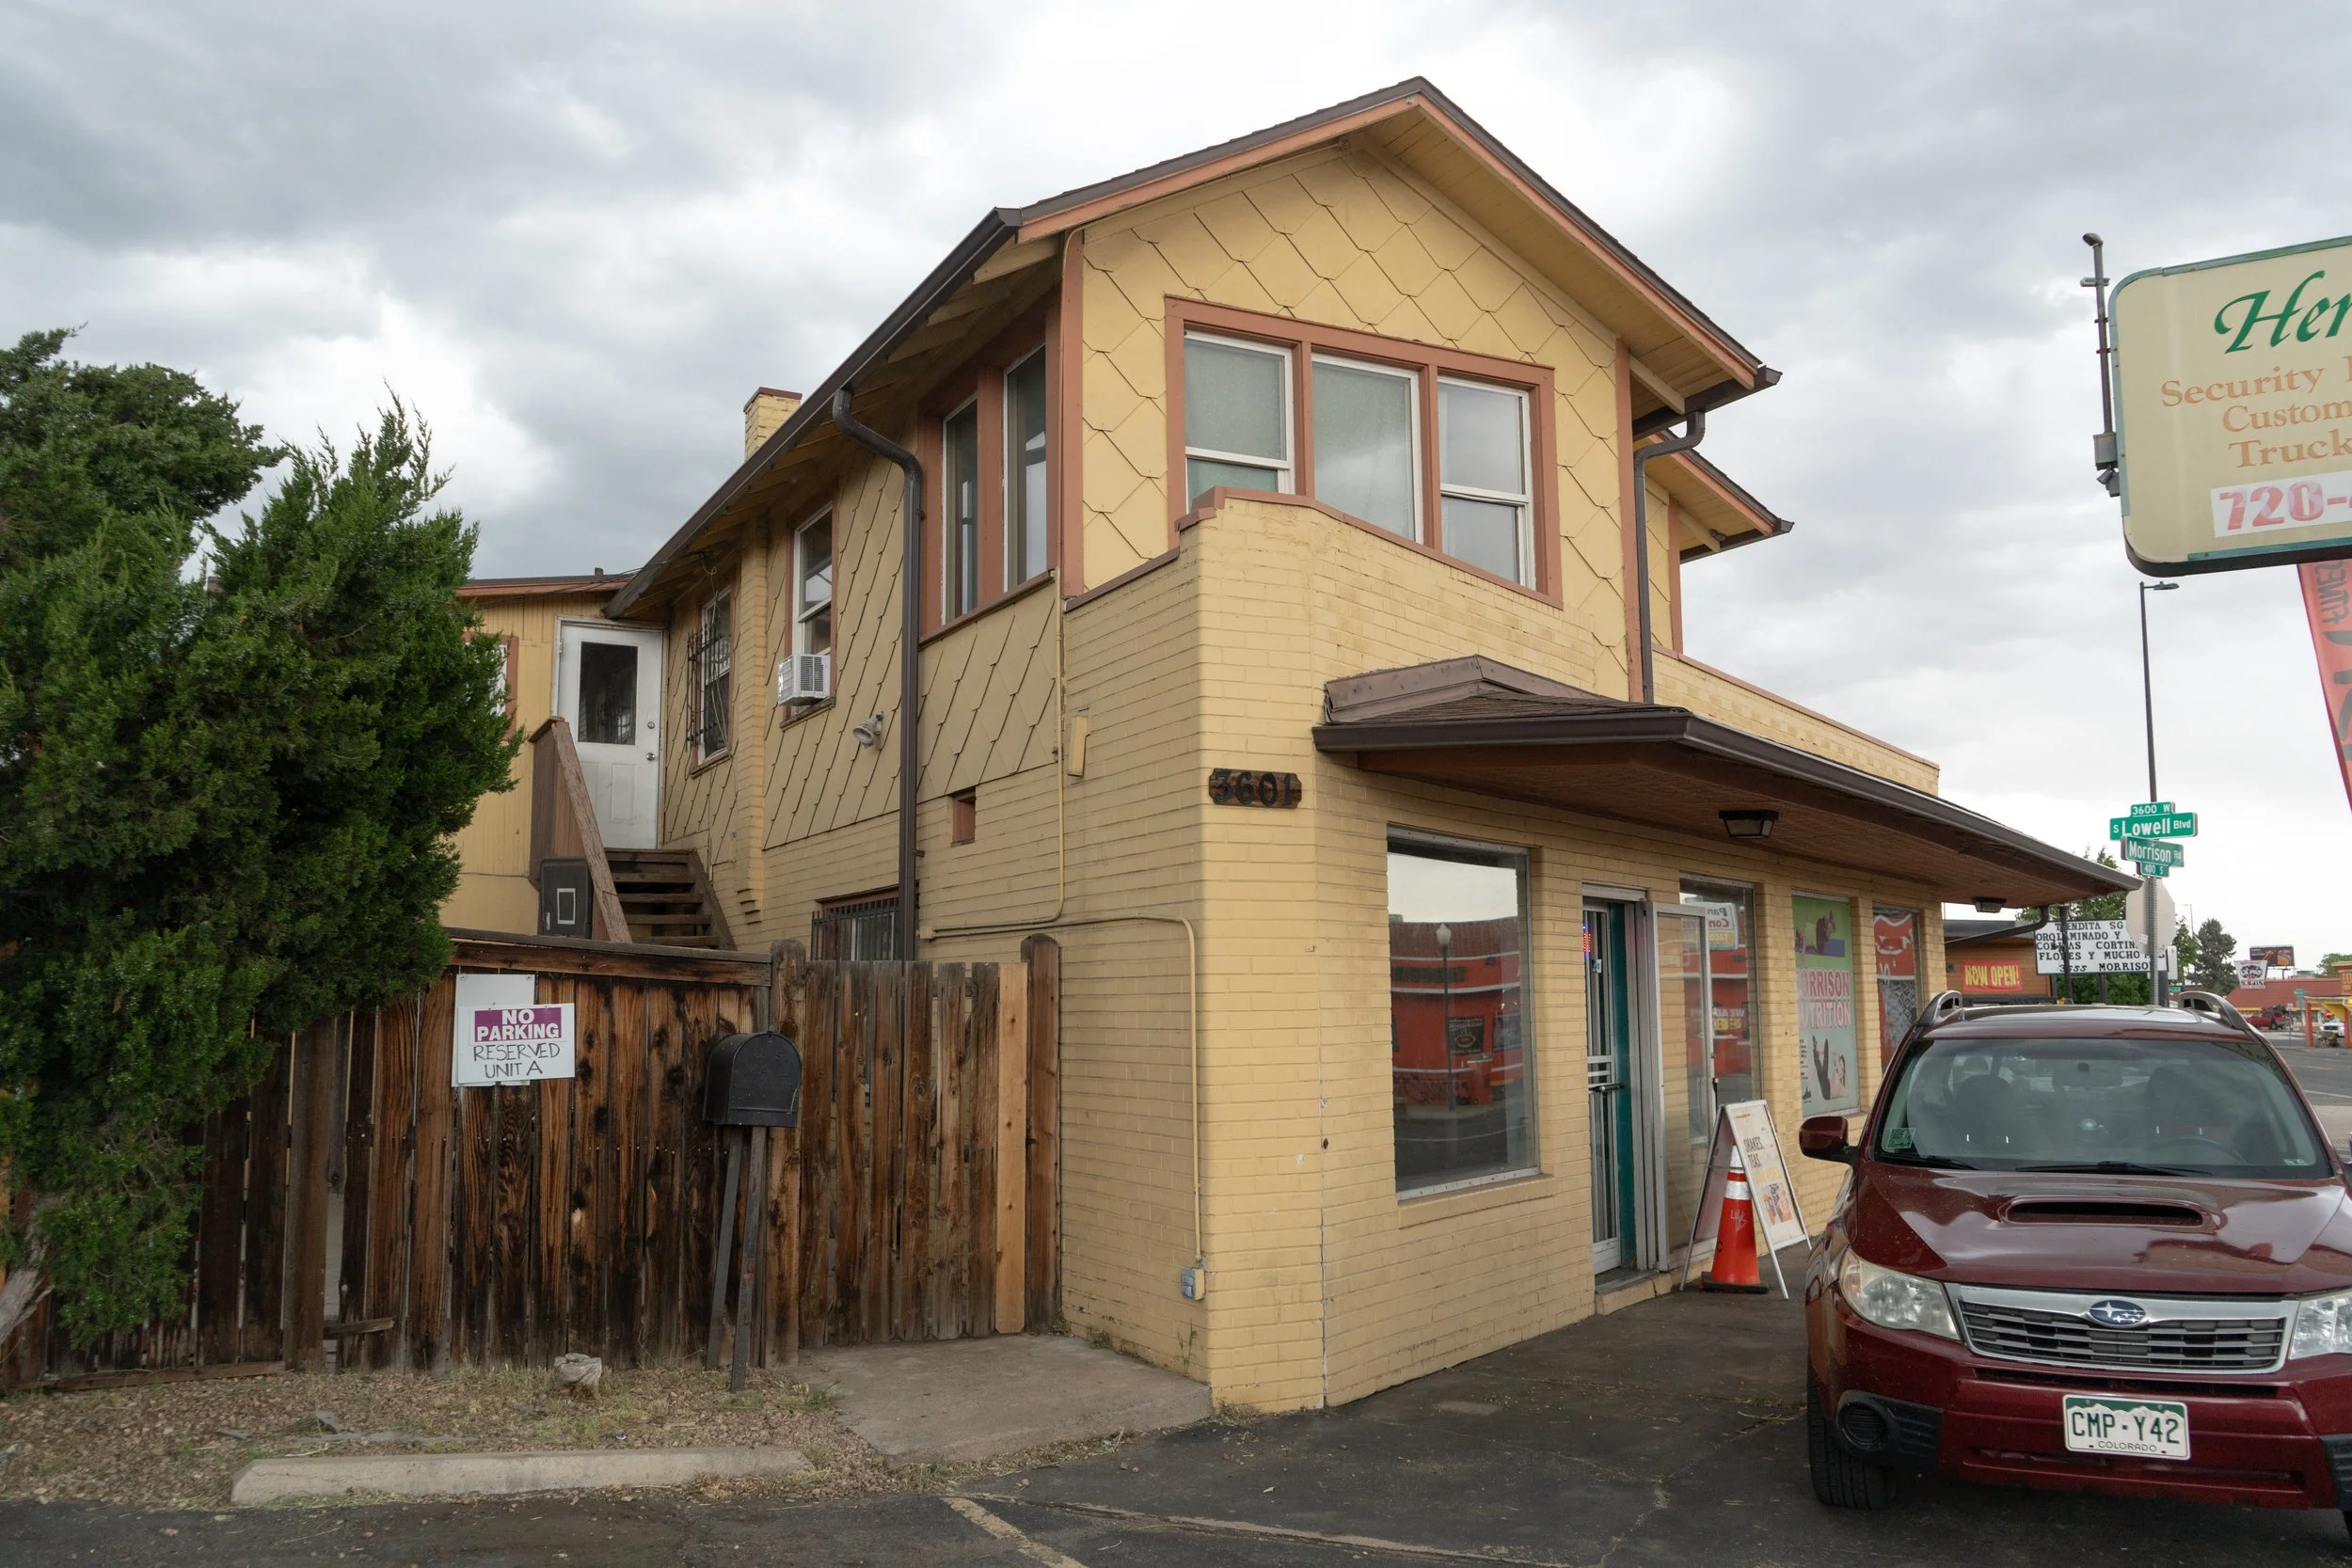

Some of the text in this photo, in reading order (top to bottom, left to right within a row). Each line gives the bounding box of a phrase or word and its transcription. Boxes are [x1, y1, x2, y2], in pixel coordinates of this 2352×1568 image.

[2214, 270, 2352, 354] Her
[2161, 366, 2325, 407] Security
[2222, 399, 2352, 433] Custom
[2228, 427, 2352, 468] Truck
[2219, 481, 2352, 531] 720-
[1214, 769, 1293, 806] 3601
[2132, 804, 2171, 816] 3600 W
[2113, 818, 2191, 836] S Lowell Blvd
[2129, 840, 2182, 863] Morrison Rd
[2144, 863, 2164, 875] 400 S
[2055, 922, 2101, 931] TENDITA
[2057, 931, 2108, 941] LMINADO
[2114, 931, 2121, 940] Y
[2037, 941, 2137, 950] COAS CORTIN
[2039, 951, 2082, 960] FLOES
[2089, 951, 2095, 959] Y
[2104, 950, 2140, 958] MUCHO
[1964, 965, 2020, 986] NOW OPEN!
[2099, 962, 2151, 971] MORRISO
[501, 1009, 534, 1024] NO
[477, 1023, 559, 1041] PARKING
[473, 1043, 560, 1061] RESERVED
[485, 1060, 543, 1078] UNIT A
[2098, 1441, 2157, 1451] COLORADO
